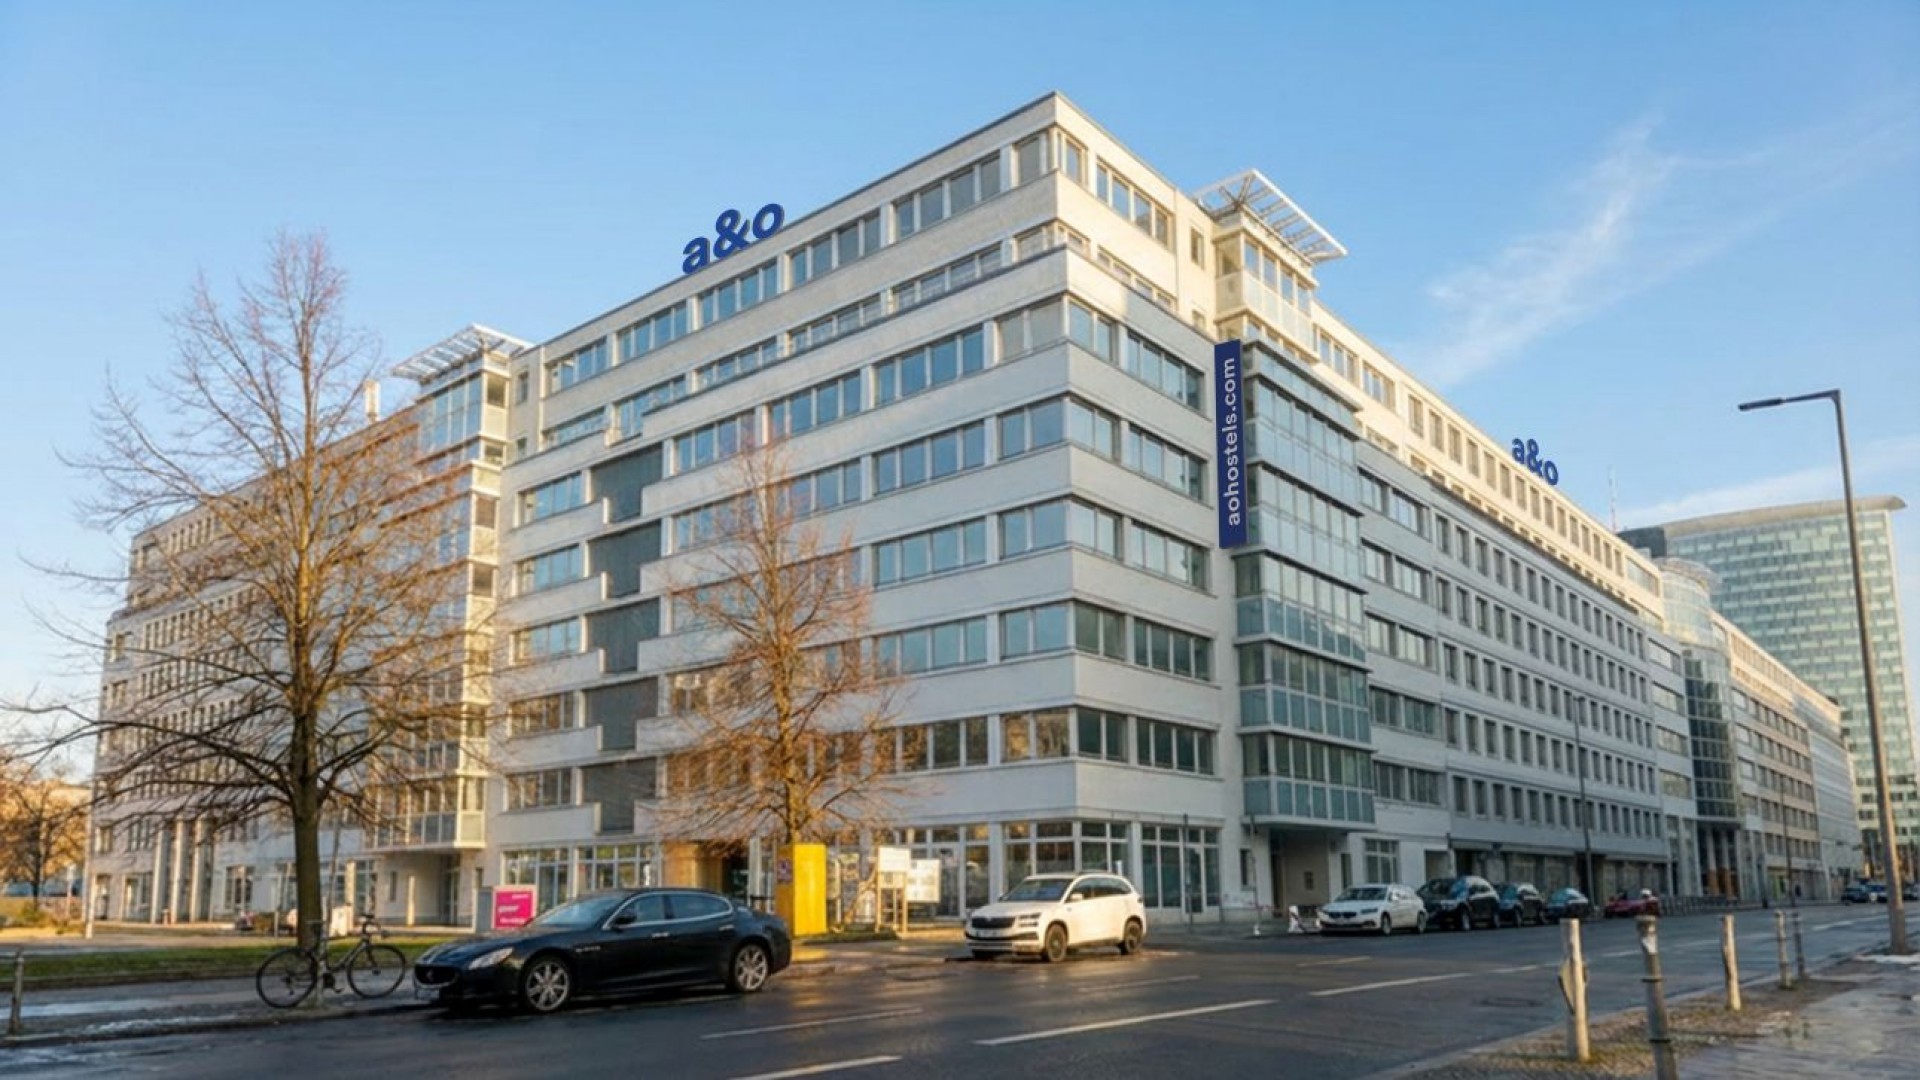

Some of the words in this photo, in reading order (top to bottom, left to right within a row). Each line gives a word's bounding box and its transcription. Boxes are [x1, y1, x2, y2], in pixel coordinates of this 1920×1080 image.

[683, 203, 784, 274] a&o
[1222, 358, 1240, 526] aohostels.com
[1512, 438, 1558, 486] a&o
